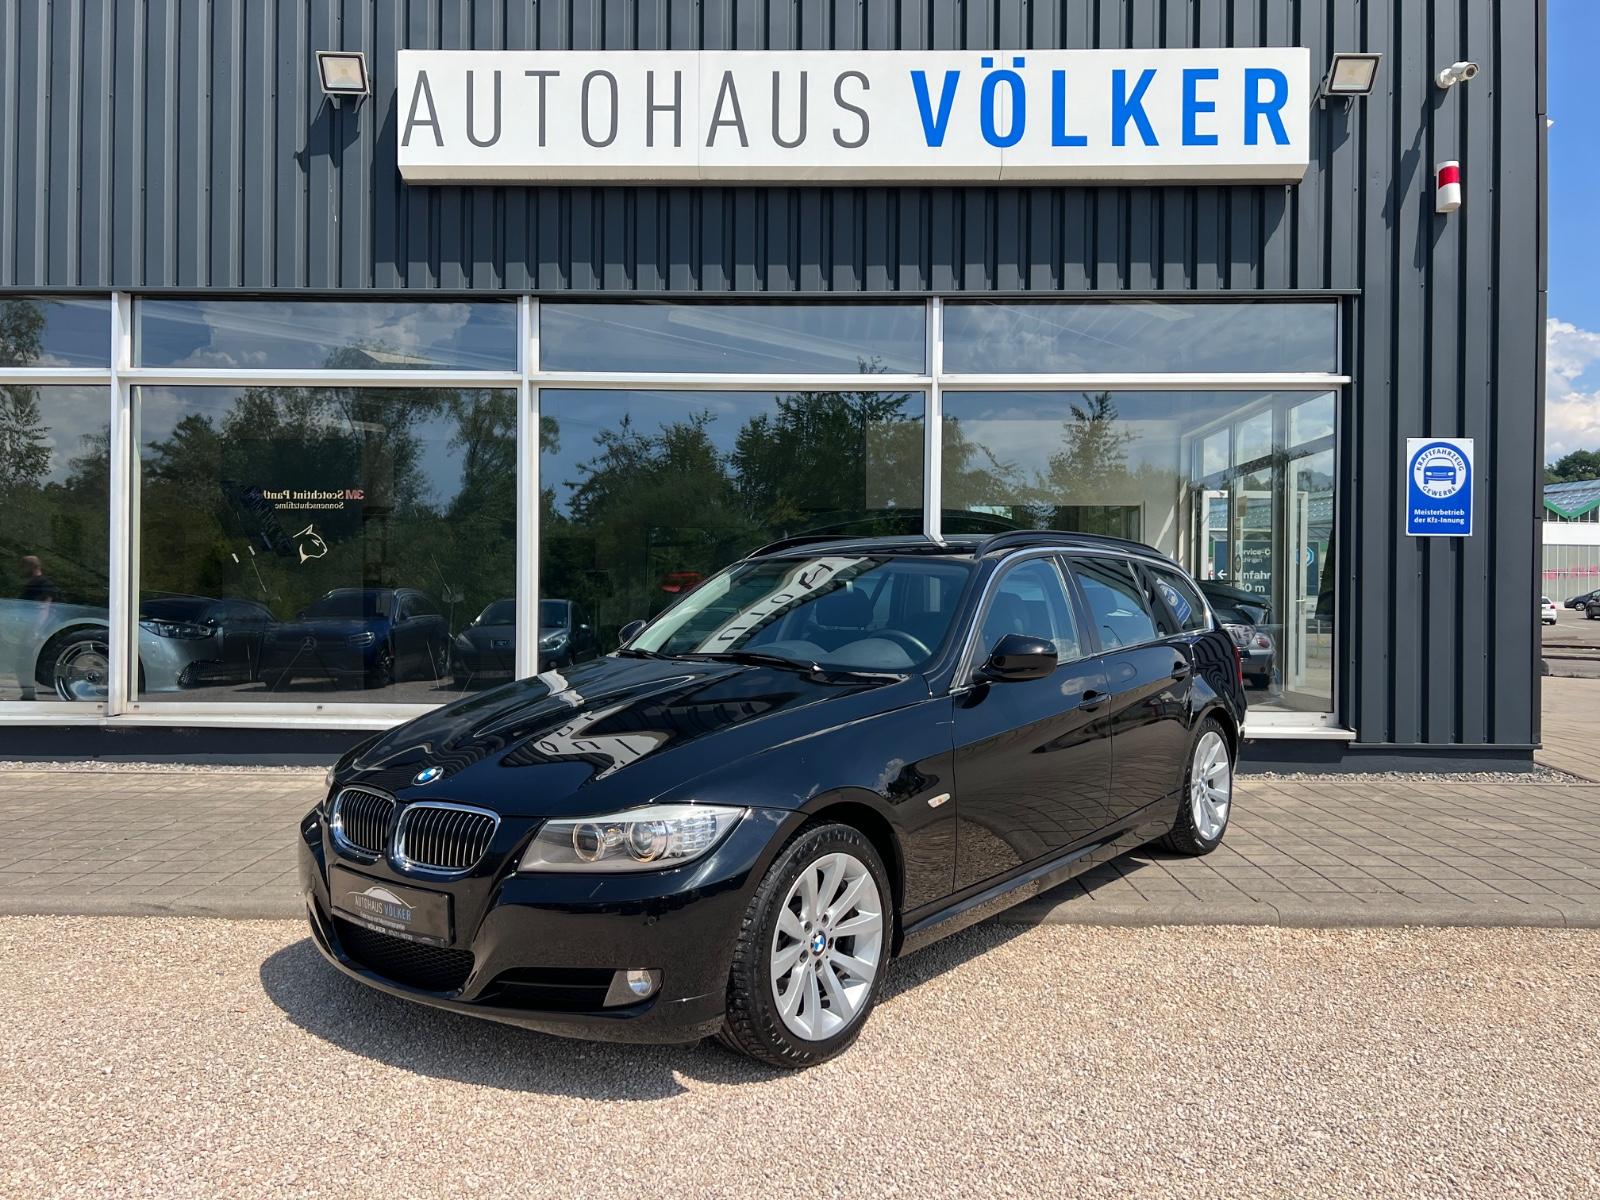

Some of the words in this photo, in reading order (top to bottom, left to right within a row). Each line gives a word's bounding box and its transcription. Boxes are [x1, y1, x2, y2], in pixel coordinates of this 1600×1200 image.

[400, 68, 872, 149] AUTOHAUS
[910, 56, 1292, 147] VÖLKER
[1416, 448, 1465, 471] KRAFTFAHRZEUG
[1422, 485, 1457, 497] GEWERBE
[1414, 508, 1465, 516] Meisterbetrieb
[1427, 517, 1465, 525] Kfz-Innung
[354, 895, 383, 914] AUTOHAUS
